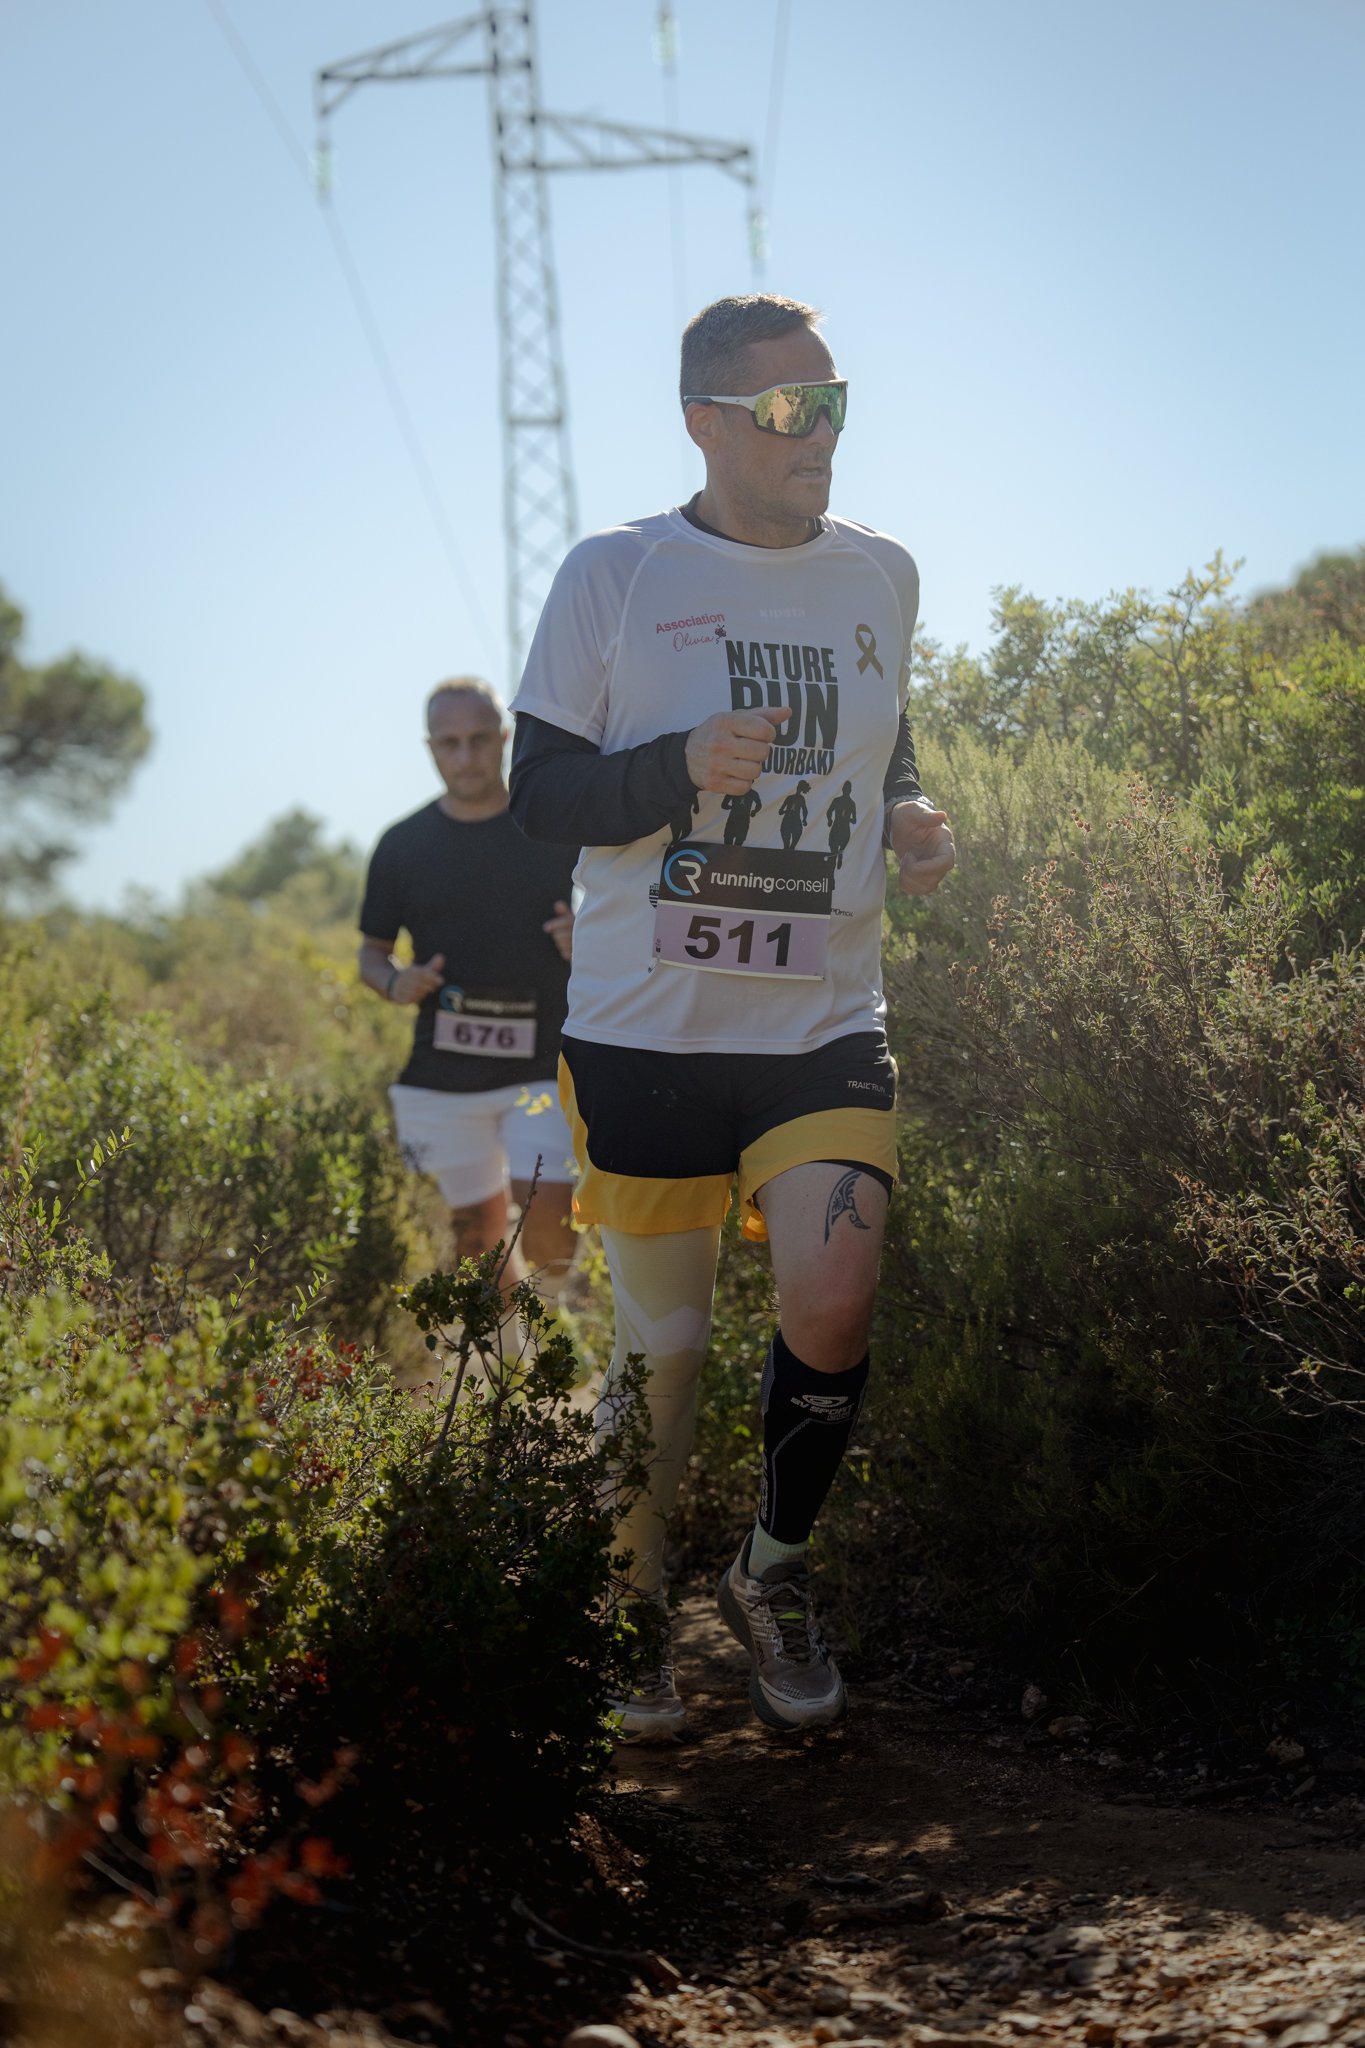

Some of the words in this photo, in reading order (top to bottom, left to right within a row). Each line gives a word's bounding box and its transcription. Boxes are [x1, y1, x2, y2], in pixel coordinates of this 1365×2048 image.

[655, 613, 726, 635] Association
[673, 631, 714, 652] Olivia
[725, 639, 838, 683] NATURE
[761, 746, 835, 776] OURBAKI
[710, 871, 829, 894] runningconseil
[684, 915, 792, 967] 511
[454, 1022, 516, 1050] 676
